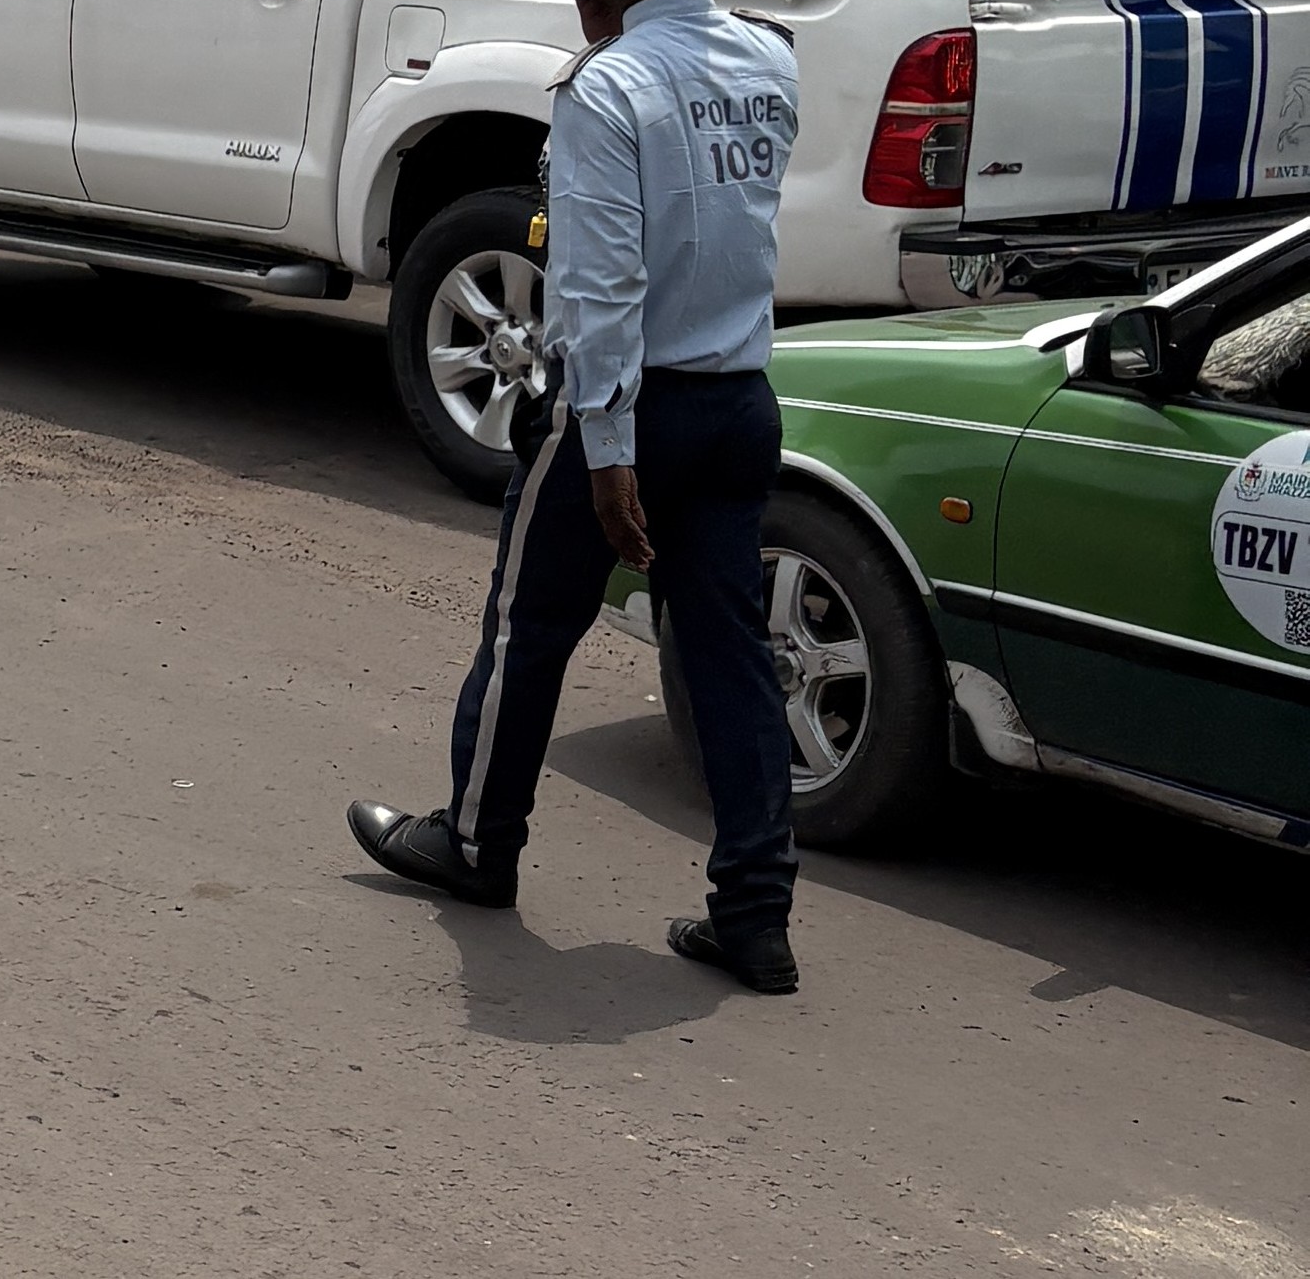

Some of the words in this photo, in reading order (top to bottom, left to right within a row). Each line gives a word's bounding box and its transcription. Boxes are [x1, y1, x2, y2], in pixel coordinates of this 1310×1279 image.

[690, 95, 783, 128] POLICE
[225, 140, 281, 162] HILUX
[710, 137, 773, 184] 109
[1270, 471, 1310, 488] MAIR
[1223, 521, 1298, 575] TBZV
